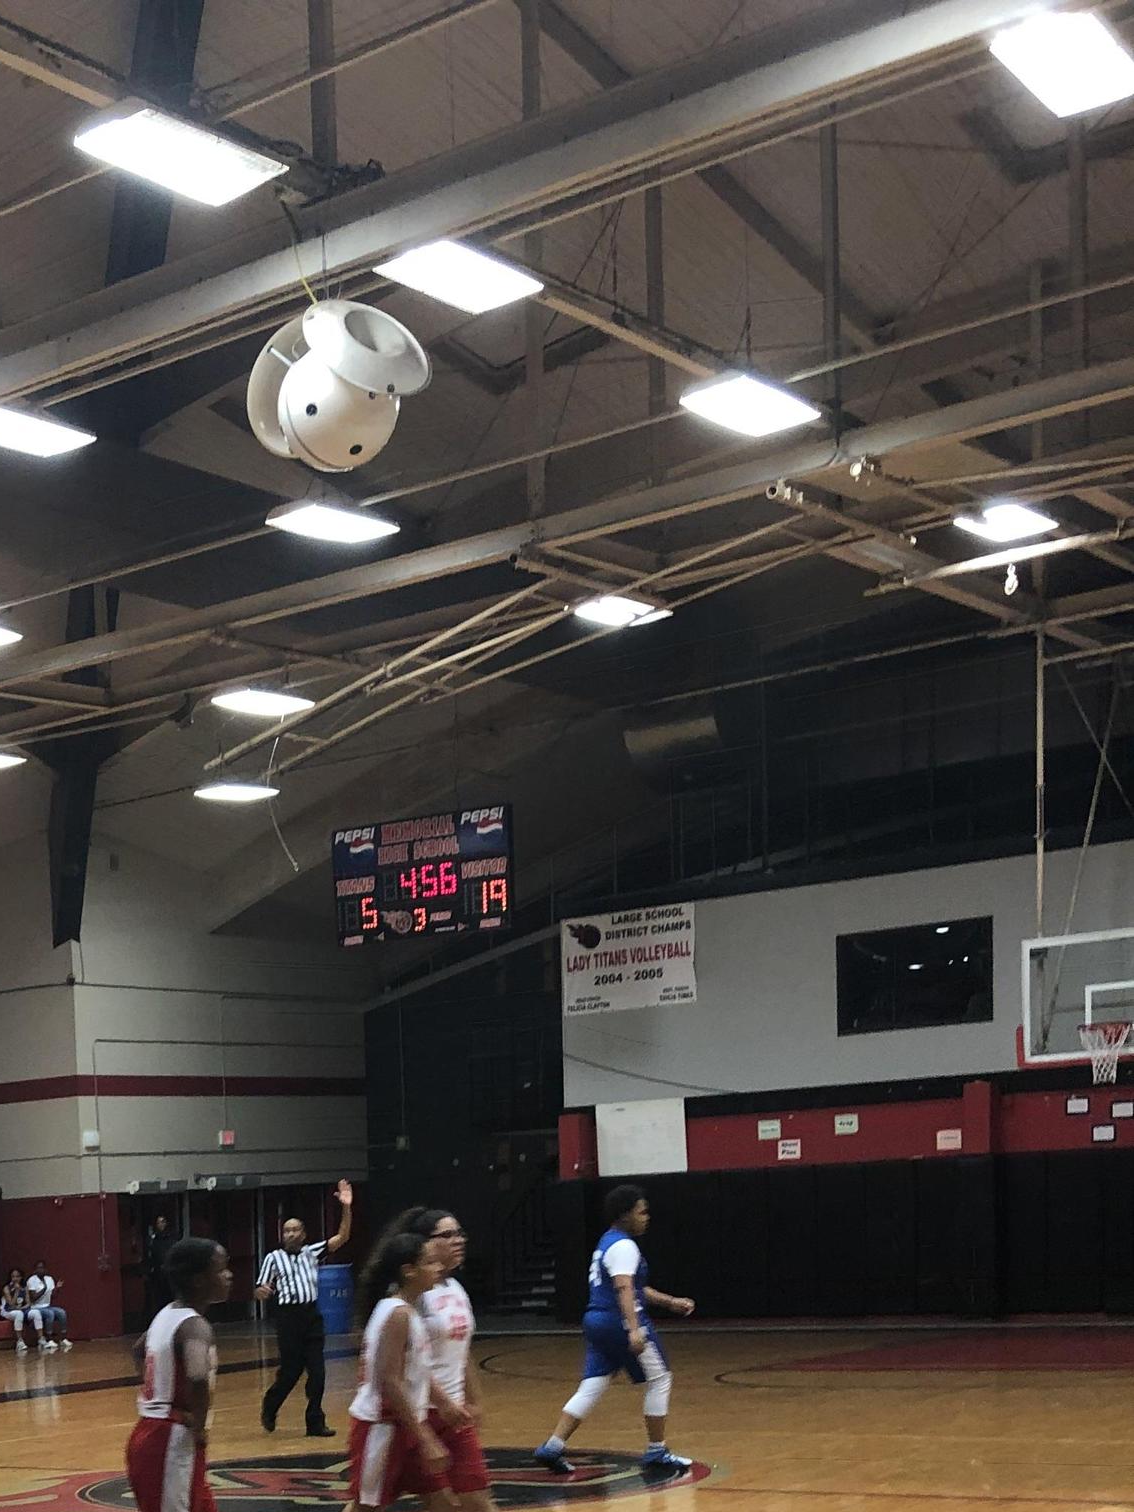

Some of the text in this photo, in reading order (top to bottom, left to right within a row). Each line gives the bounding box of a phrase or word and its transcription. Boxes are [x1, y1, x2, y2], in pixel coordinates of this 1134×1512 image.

[460, 806, 504, 825] PEPSI
[334, 827, 376, 845] PEPSI
[482, 879, 508, 914] 19
[360, 897, 378, 930] 5
[413, 907, 427, 932] 3
[611, 906, 685, 925] LARGE SCHOOL
[605, 920, 692, 941] DISTRICT CHAMPS
[567, 940, 692, 973] LADY TITANS VOLLEYBALL
[594, 973, 624, 986] 2004
